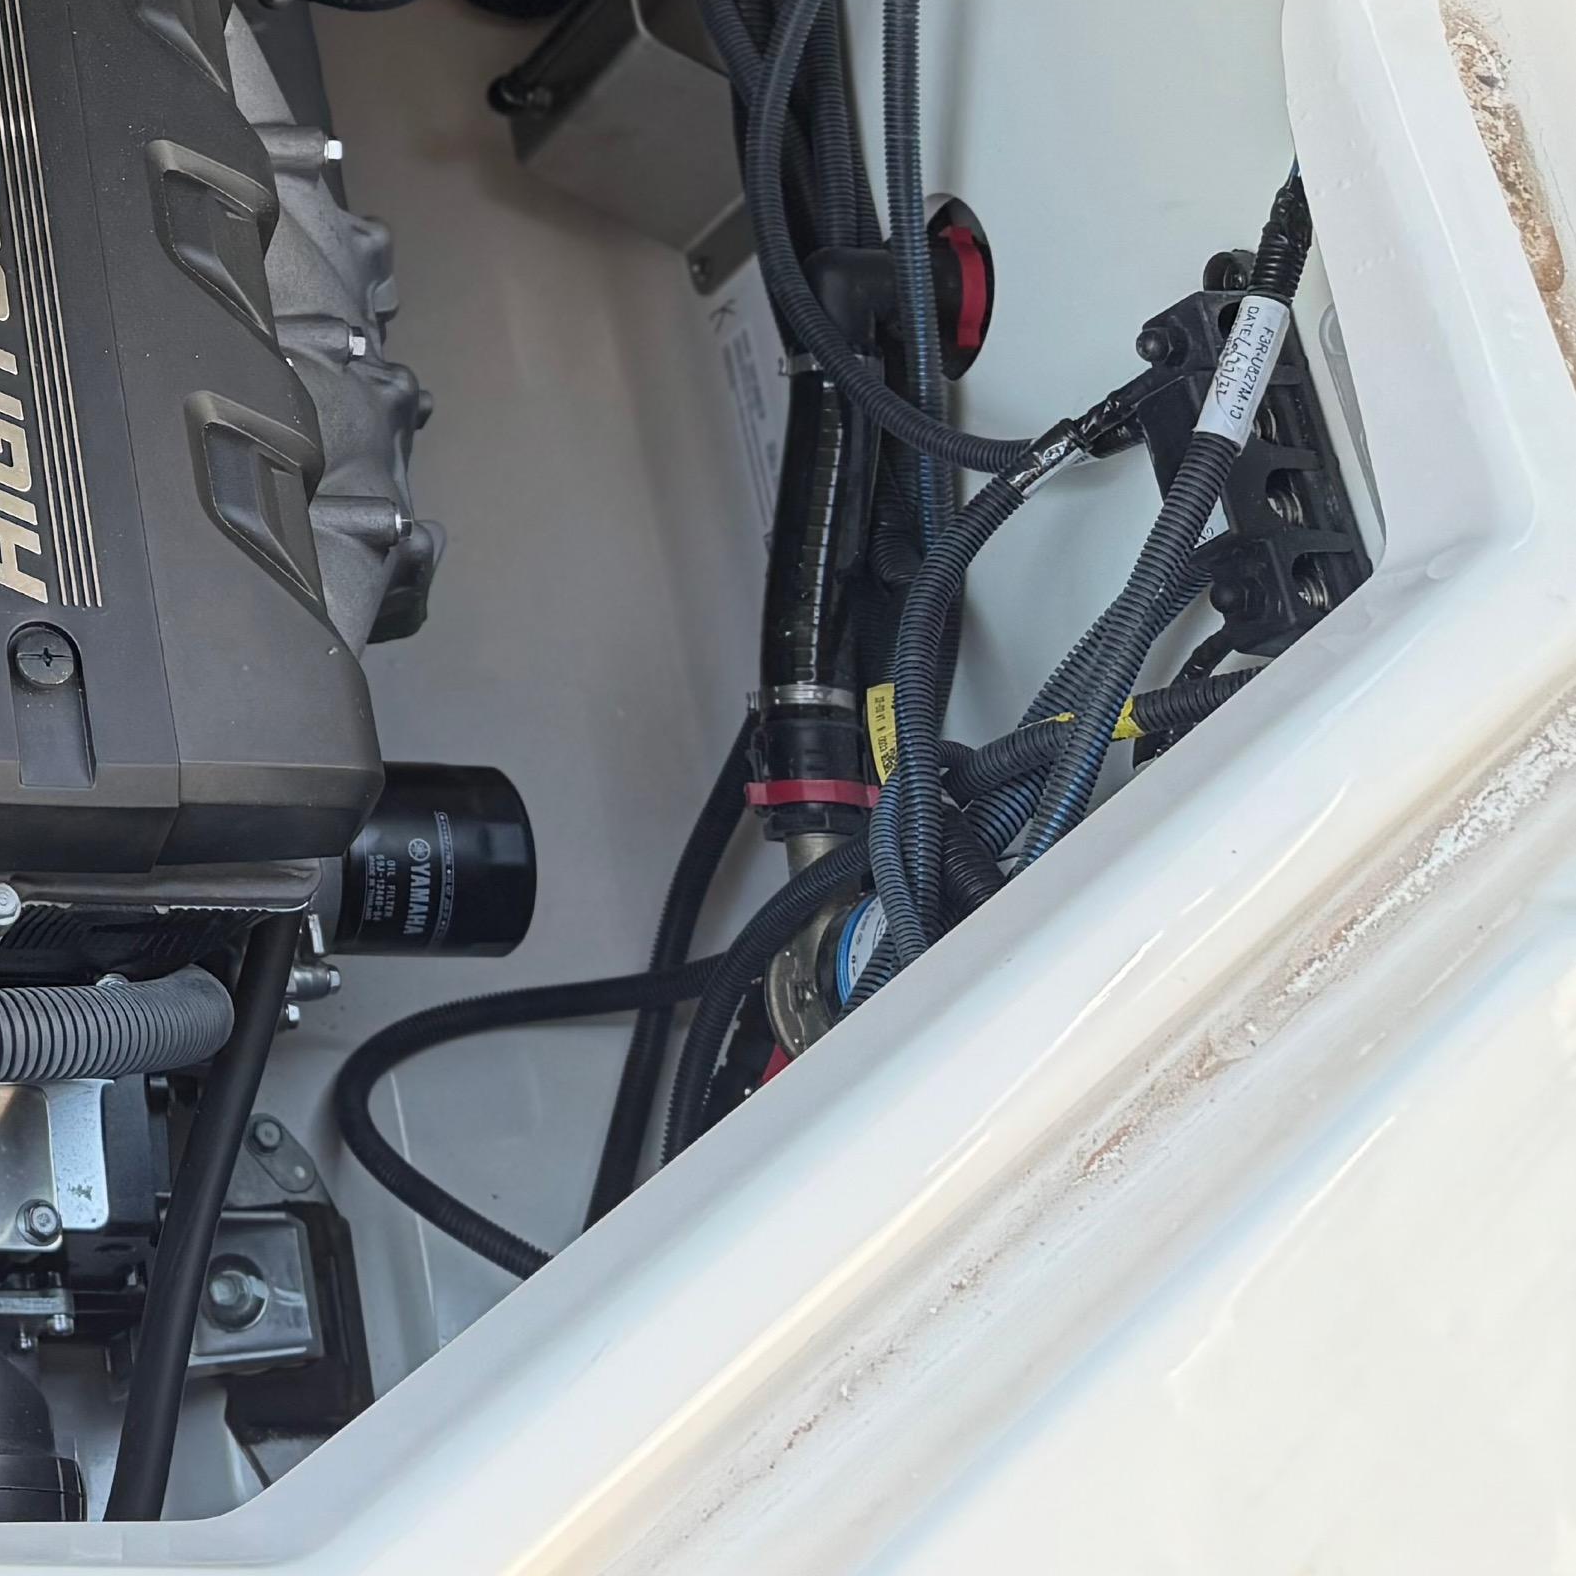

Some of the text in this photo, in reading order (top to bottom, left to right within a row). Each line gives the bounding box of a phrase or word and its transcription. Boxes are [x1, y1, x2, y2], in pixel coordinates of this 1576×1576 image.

[1239, 306, 1260, 337] DATE
[384, 860, 396, 918] OIL FILTER
[403, 862, 431, 935] YAMAHA
